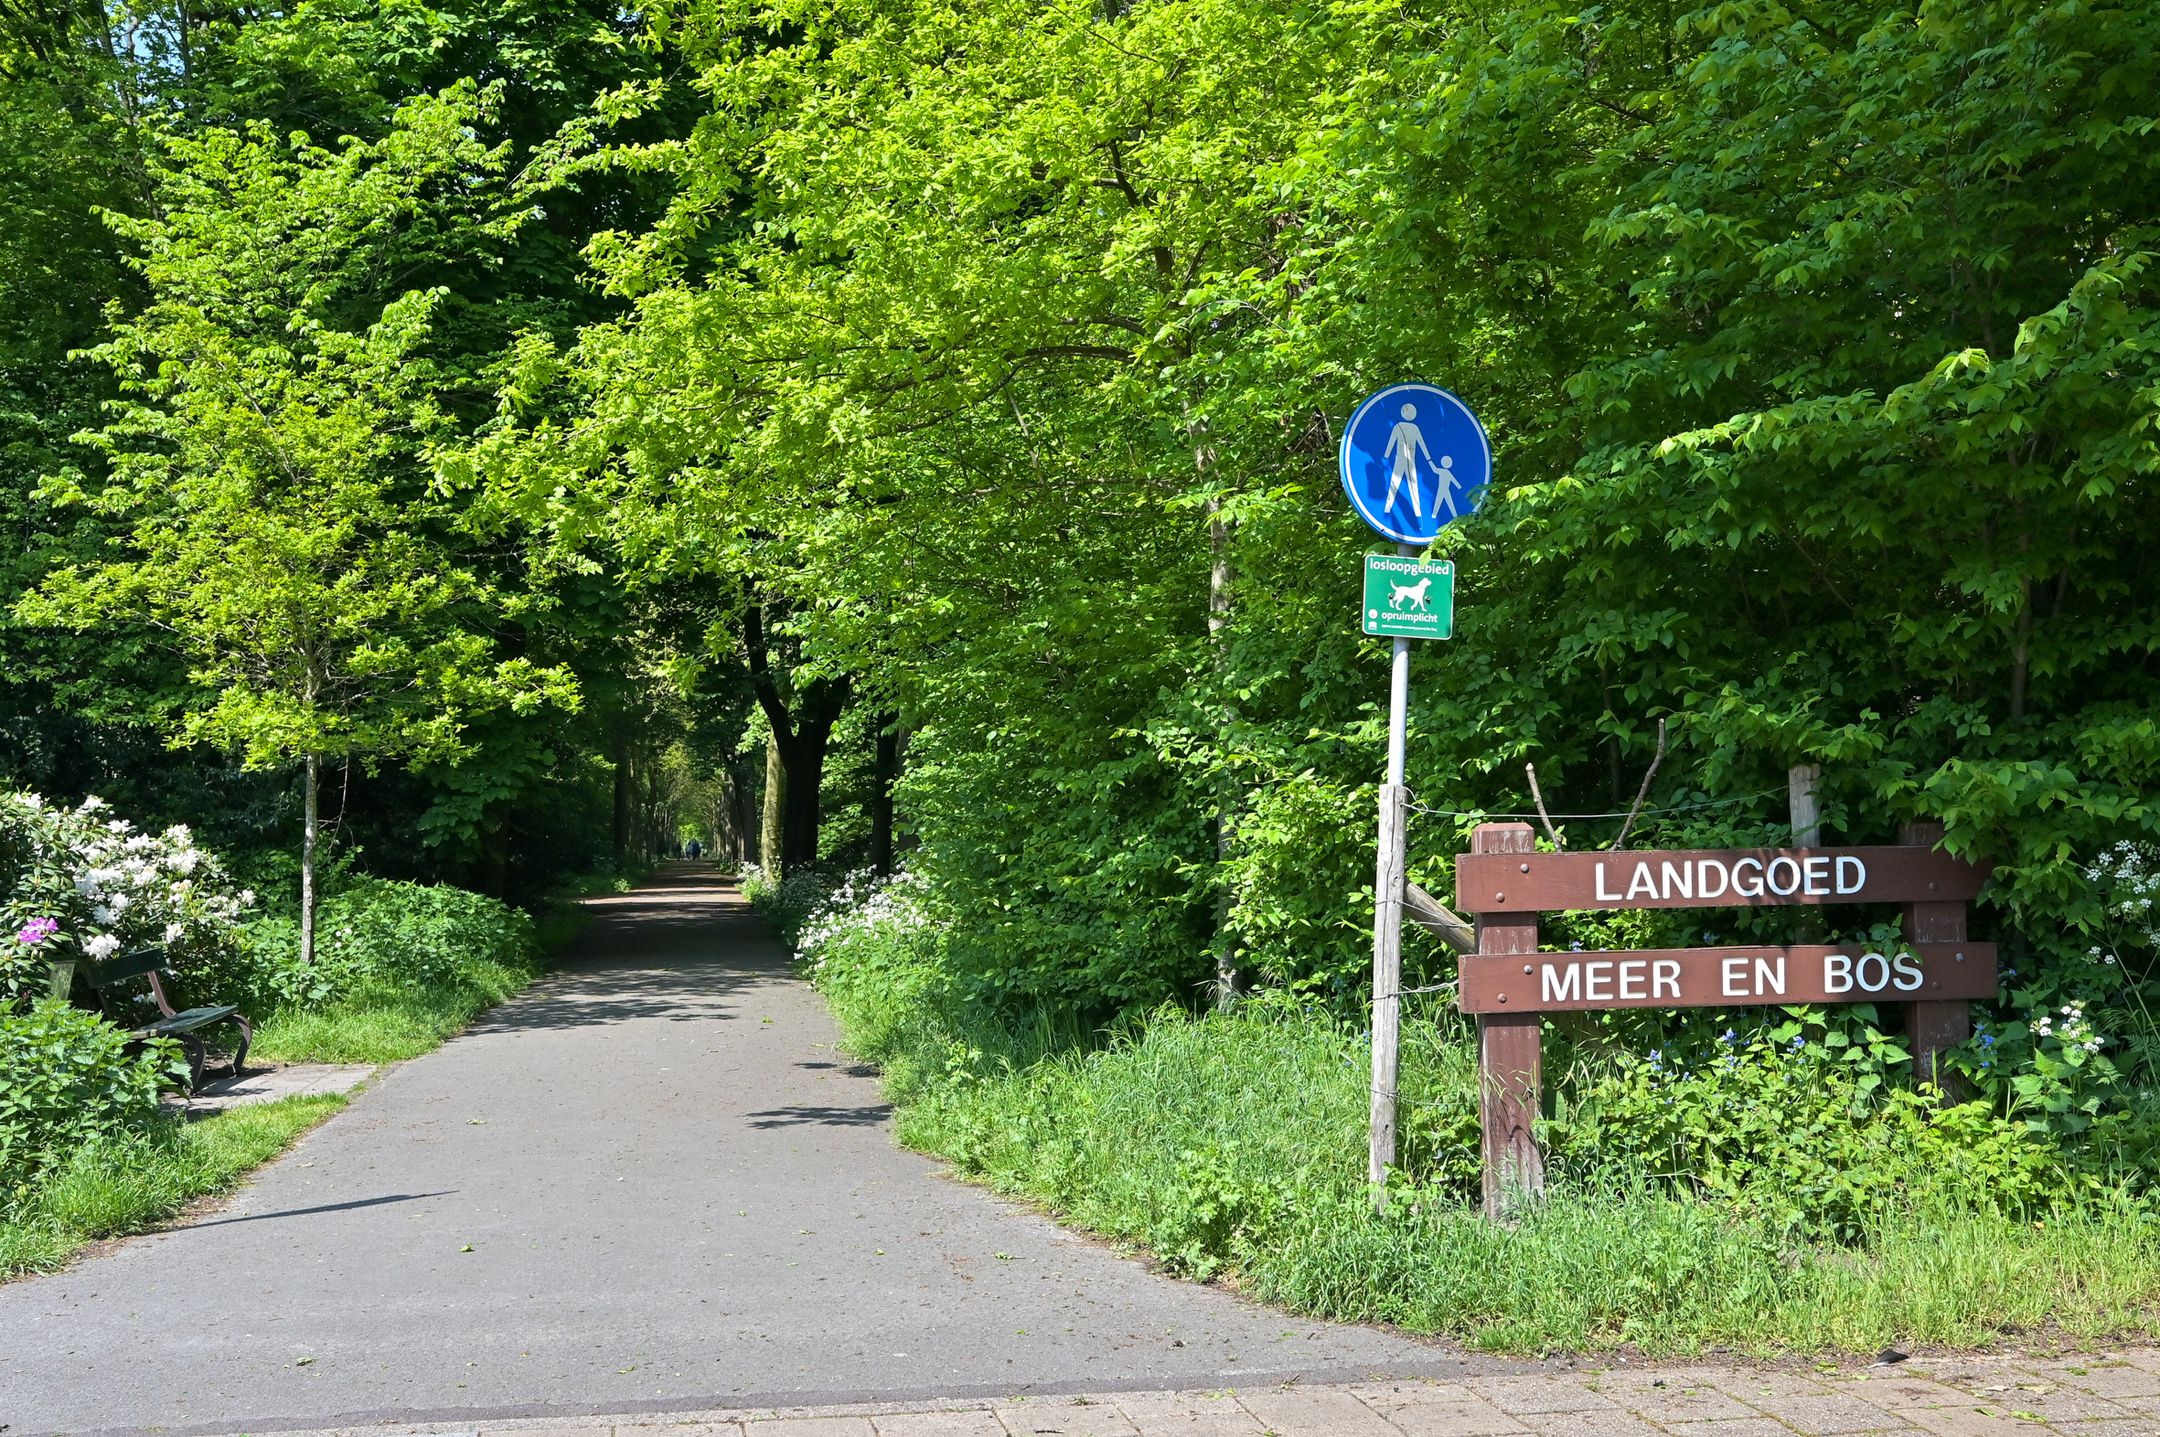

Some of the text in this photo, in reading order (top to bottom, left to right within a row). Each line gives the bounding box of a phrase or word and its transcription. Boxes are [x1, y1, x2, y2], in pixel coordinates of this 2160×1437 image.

[1381, 612, 1438, 624] opruimplicht
[1595, 856, 1866, 901] LANDGOED
[1541, 952, 1924, 1002] MEER EN BOS
